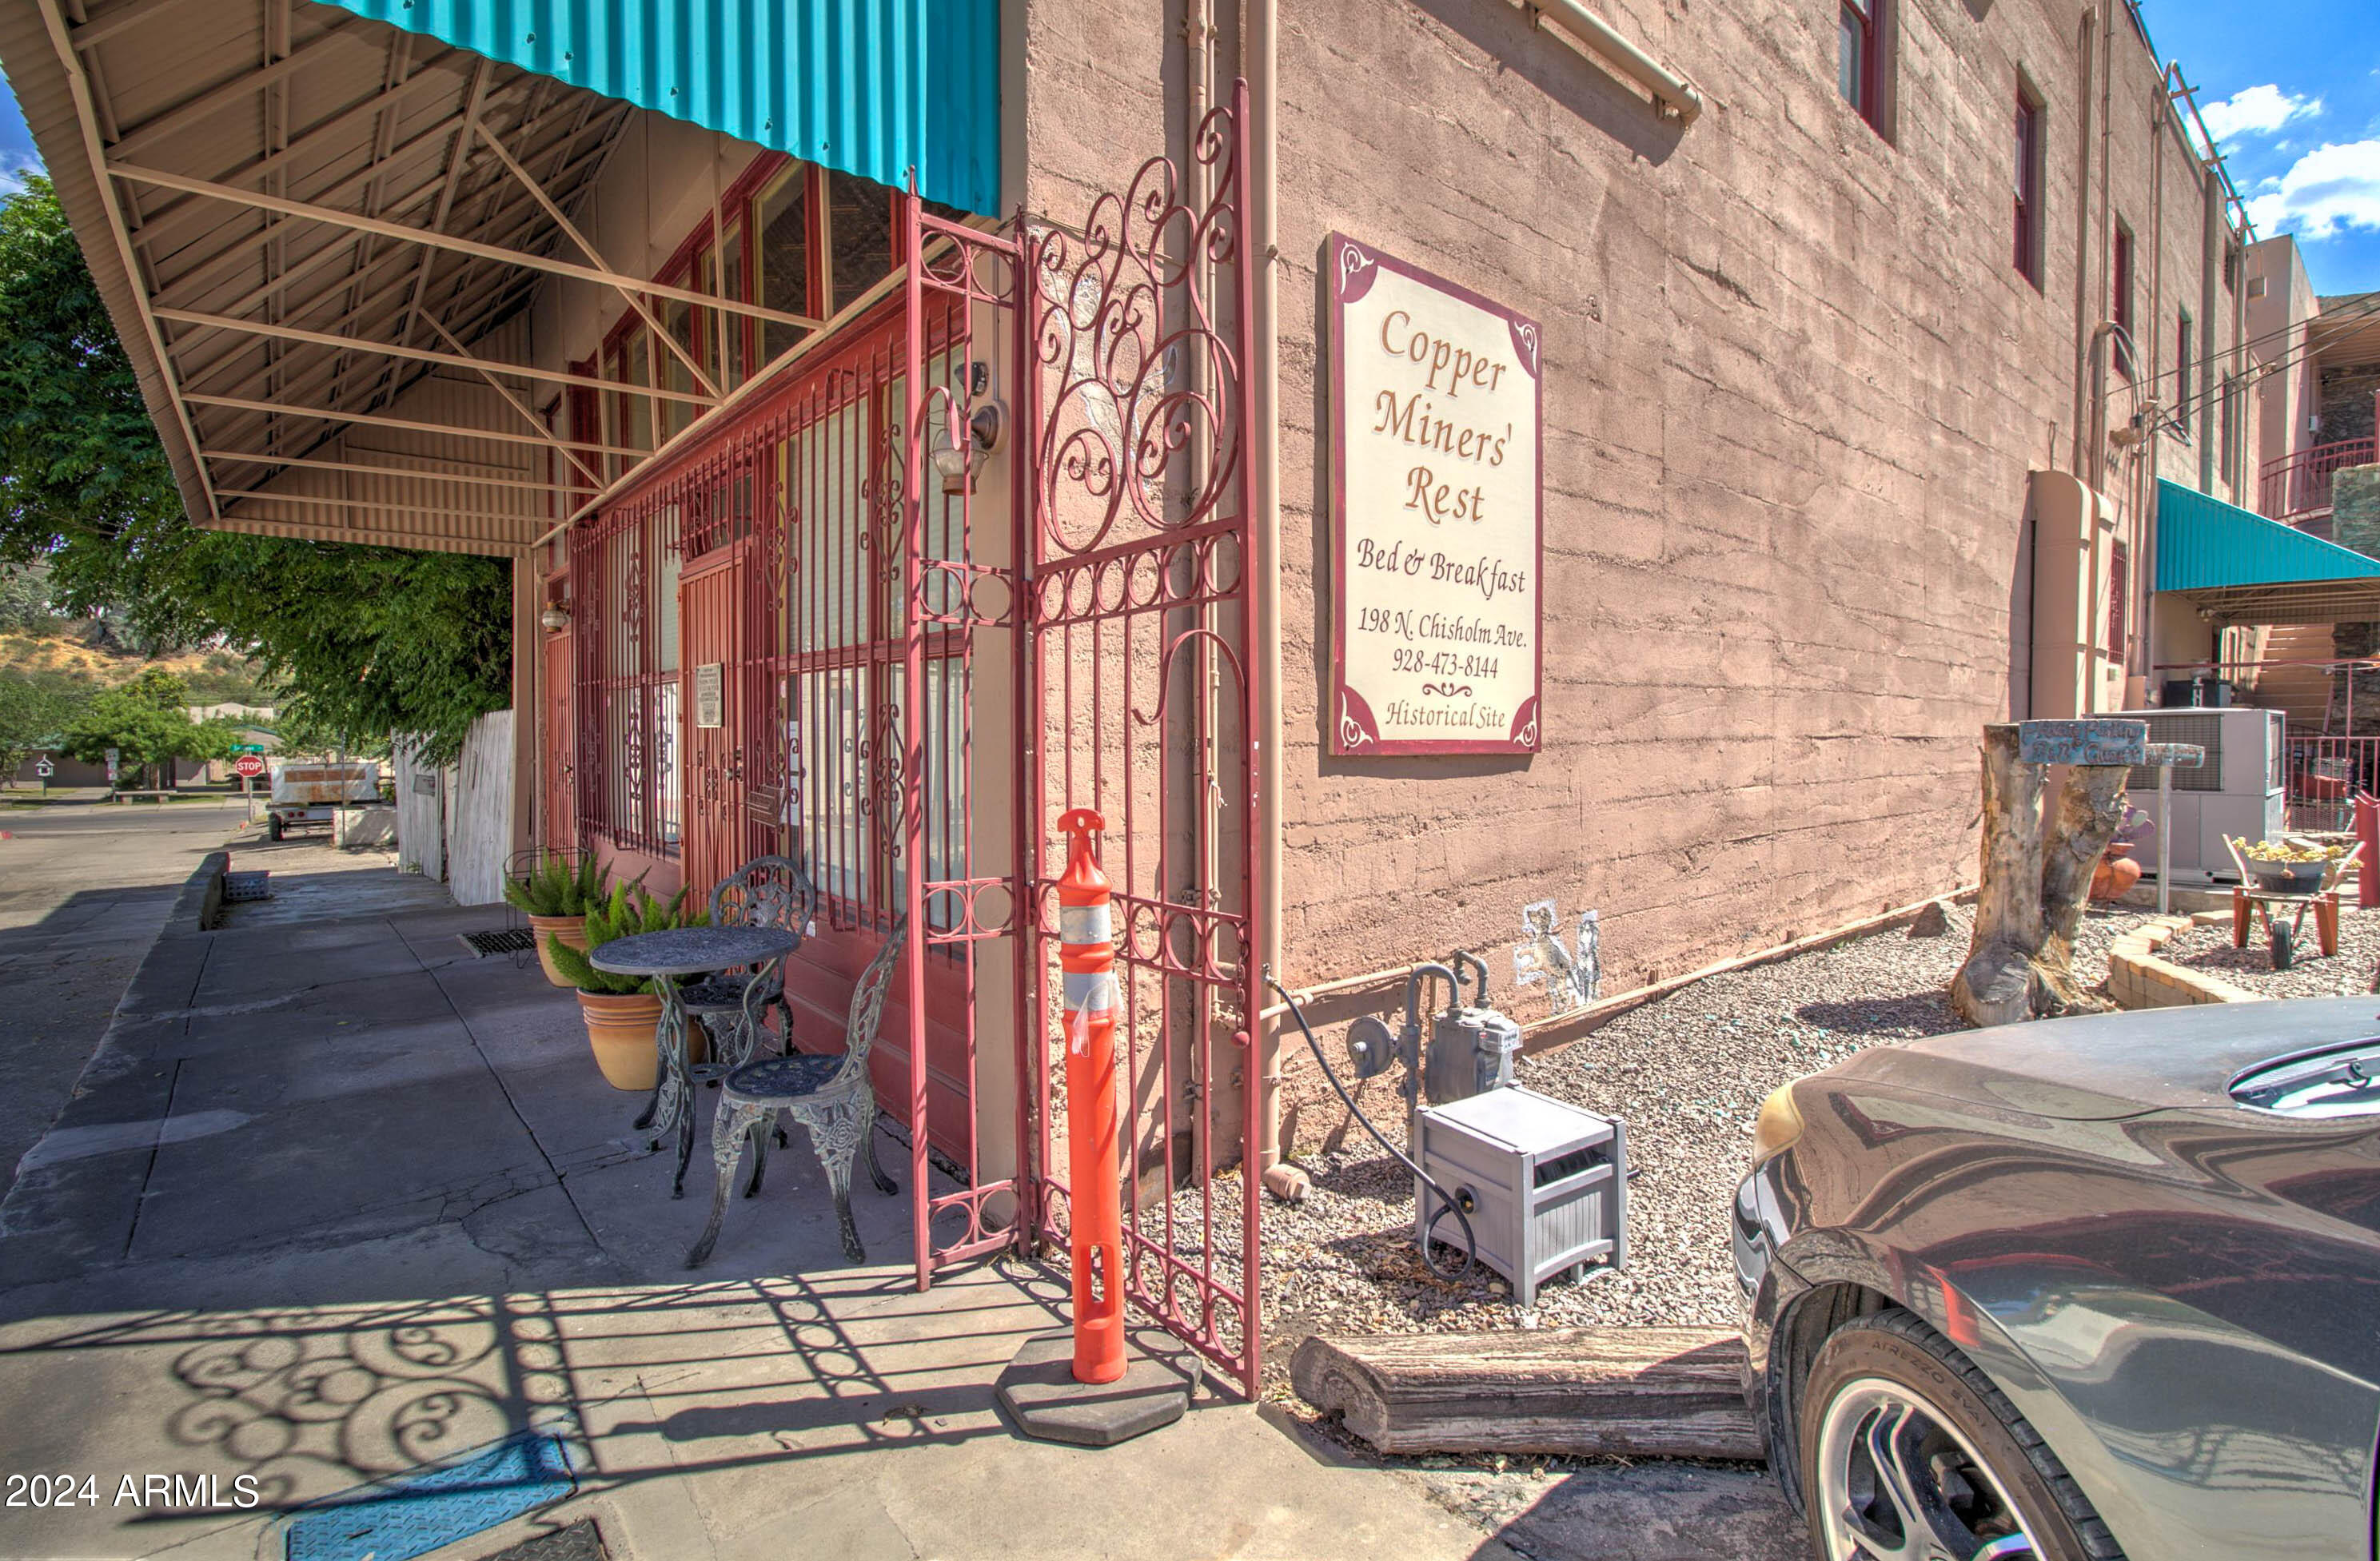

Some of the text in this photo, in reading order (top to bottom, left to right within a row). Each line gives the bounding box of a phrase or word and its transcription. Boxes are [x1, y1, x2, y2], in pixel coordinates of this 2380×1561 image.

[1381, 310, 1506, 398] Copper
[1373, 389, 1513, 466] Miners'
[1405, 465, 1485, 525] Rest
[1357, 538, 1526, 601] Bed & Breakfast
[1357, 607, 1527, 647] 198 N. Chisholm Ave.
[1392, 648, 1498, 679] 928-473-8144
[1385, 699, 1505, 729] Historical Site
[237, 762, 261, 771] STOP
